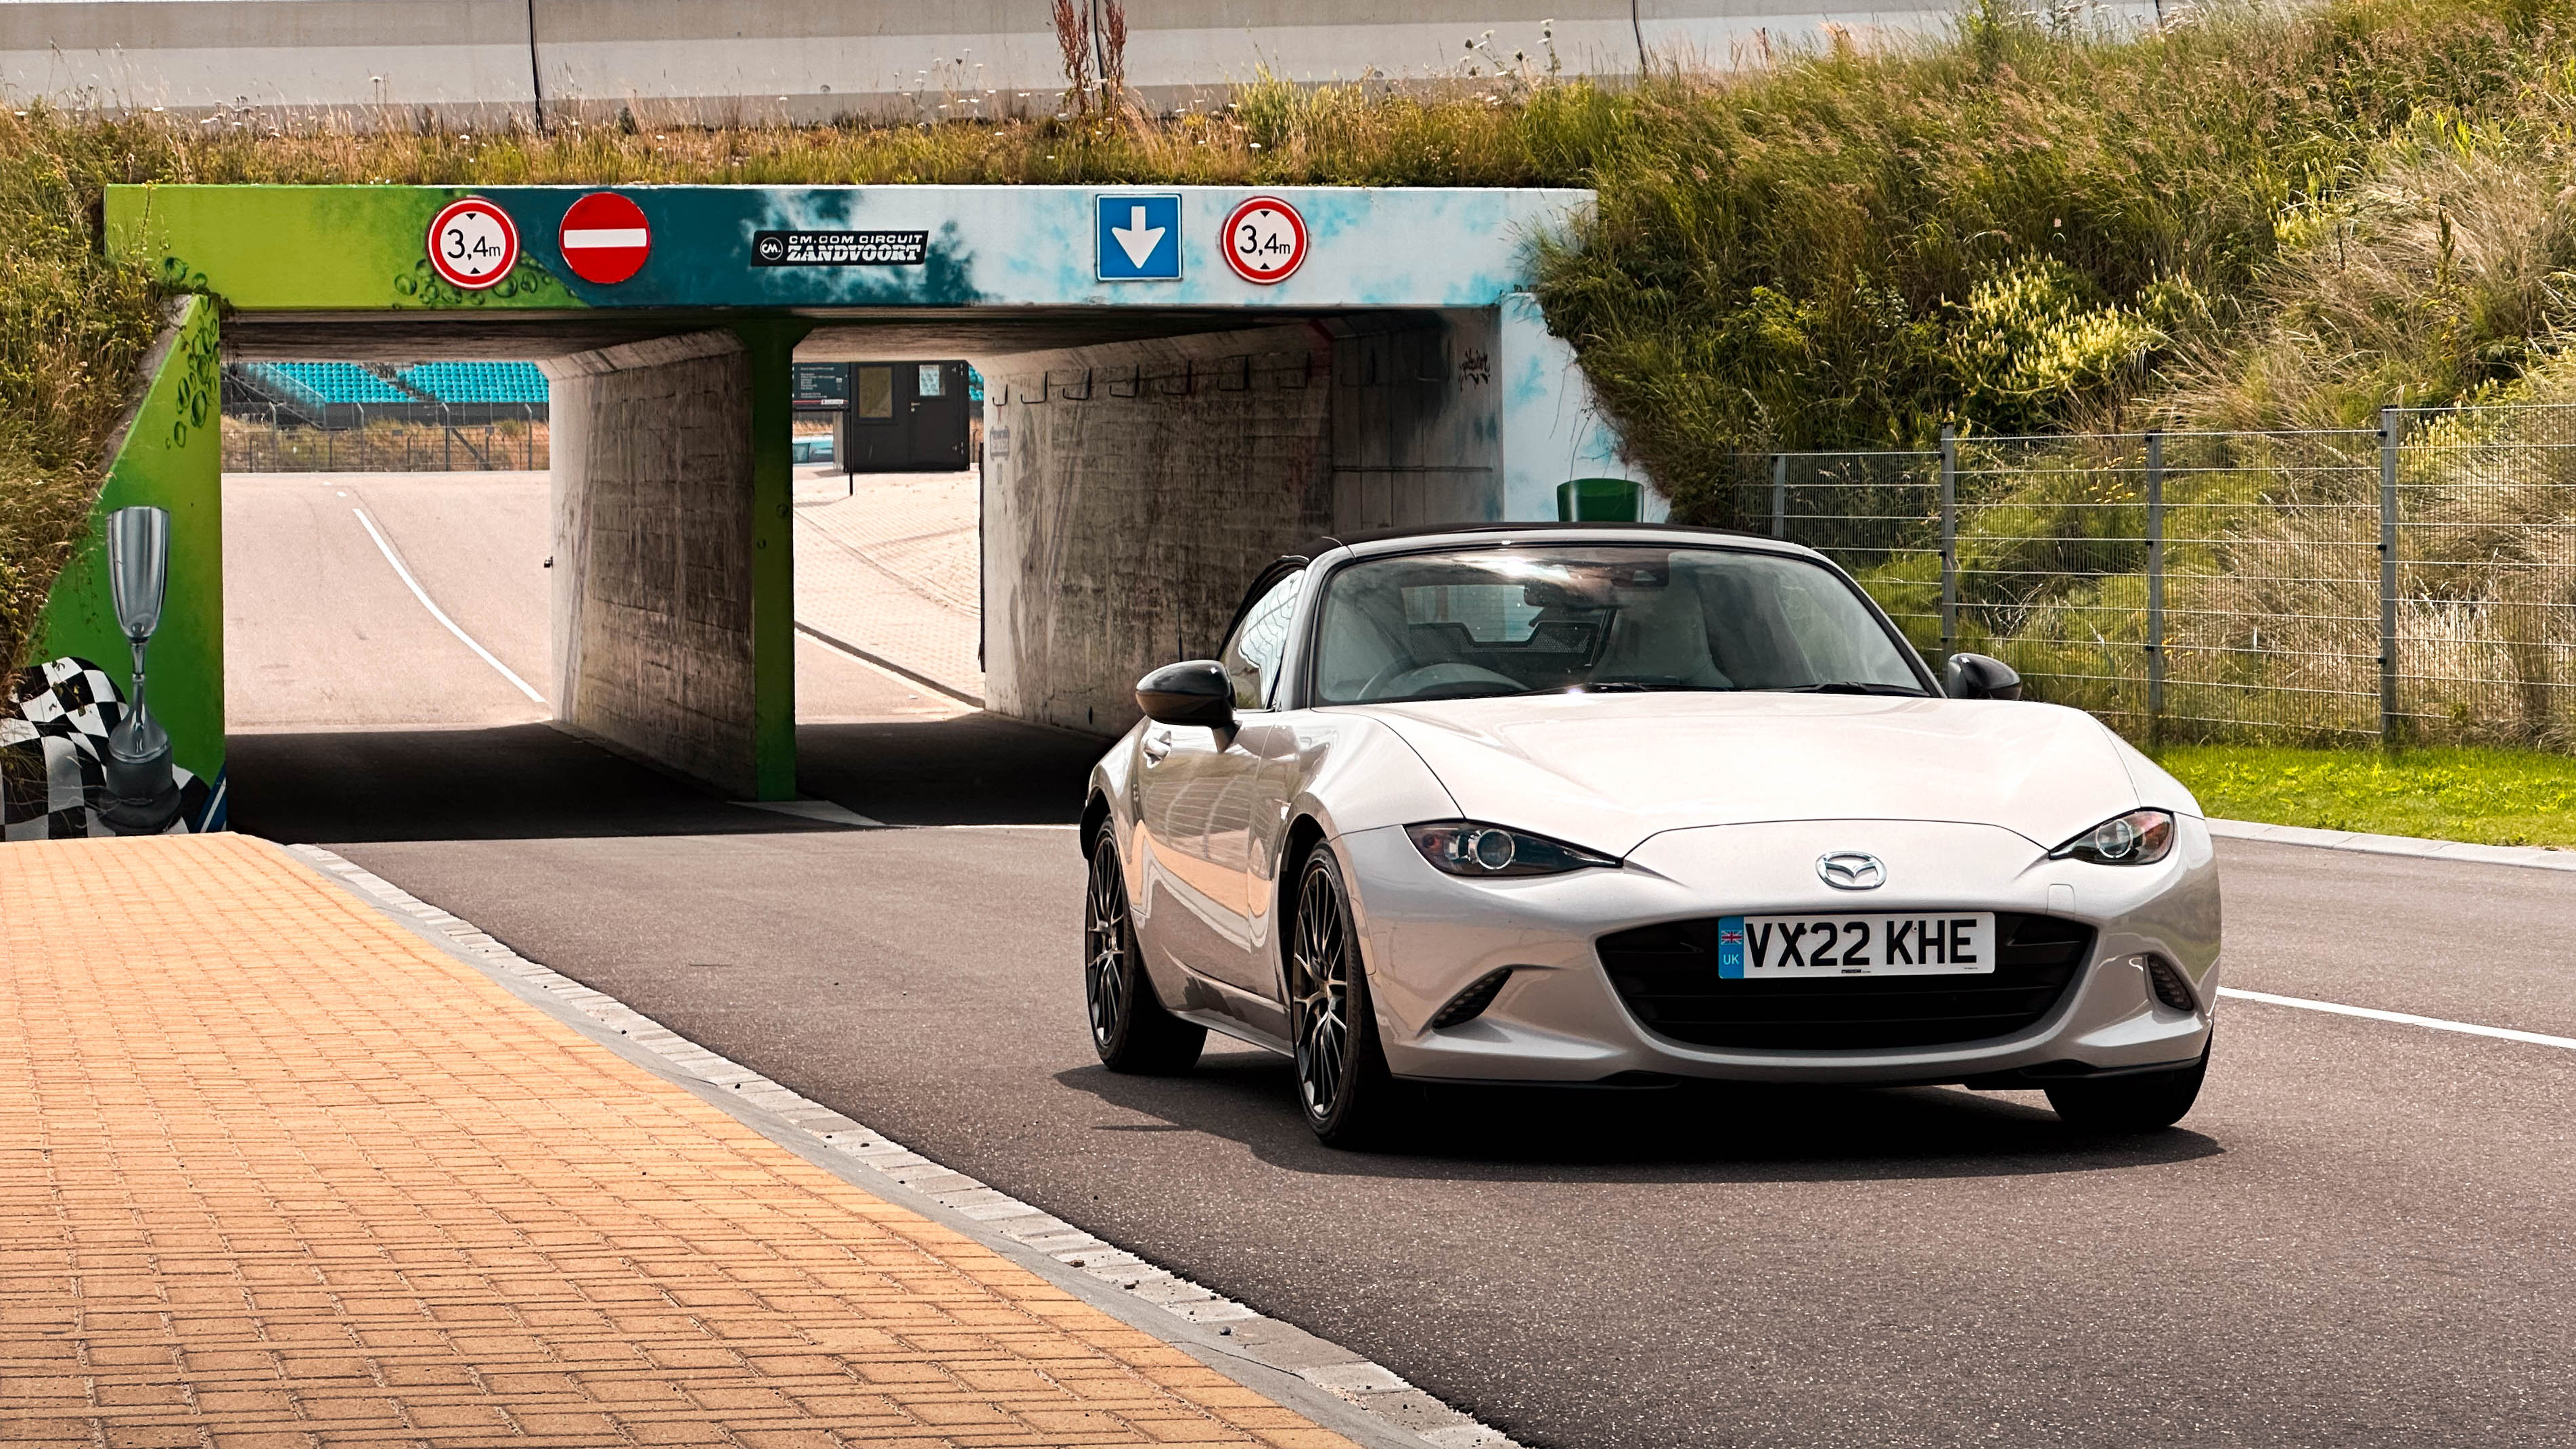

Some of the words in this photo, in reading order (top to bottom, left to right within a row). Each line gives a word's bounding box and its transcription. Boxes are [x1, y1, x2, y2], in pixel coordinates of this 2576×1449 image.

[447, 228, 501, 260] 3,4m
[788, 235, 854, 244] CM.COM
[859, 234, 923, 244] CIRCUIT
[1240, 225, 1290, 256] 3,4m
[786, 244, 921, 261] ZANDVOORT
[1745, 921, 1871, 967] VX22
[1886, 919, 1978, 965] KHE
[1723, 953, 1740, 966] UK
